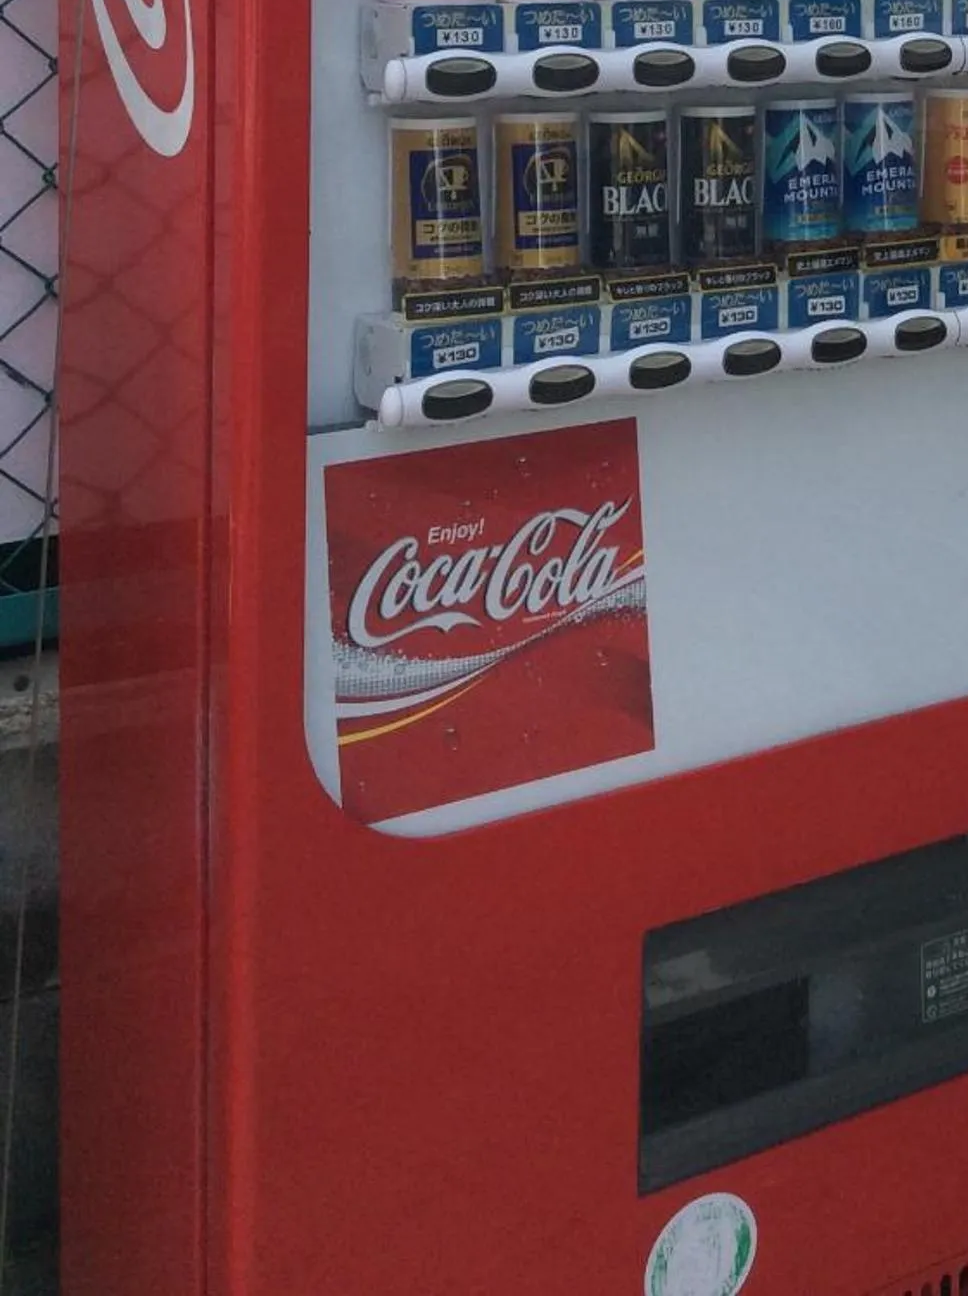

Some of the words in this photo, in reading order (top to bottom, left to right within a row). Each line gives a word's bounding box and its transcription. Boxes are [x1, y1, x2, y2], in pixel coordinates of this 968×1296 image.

[602, 182, 667, 216] BLAC
[436, 348, 477, 364] ¥130
[427, 518, 485, 545] Enjoy!
[347, 493, 634, 649] Coca-Cola
